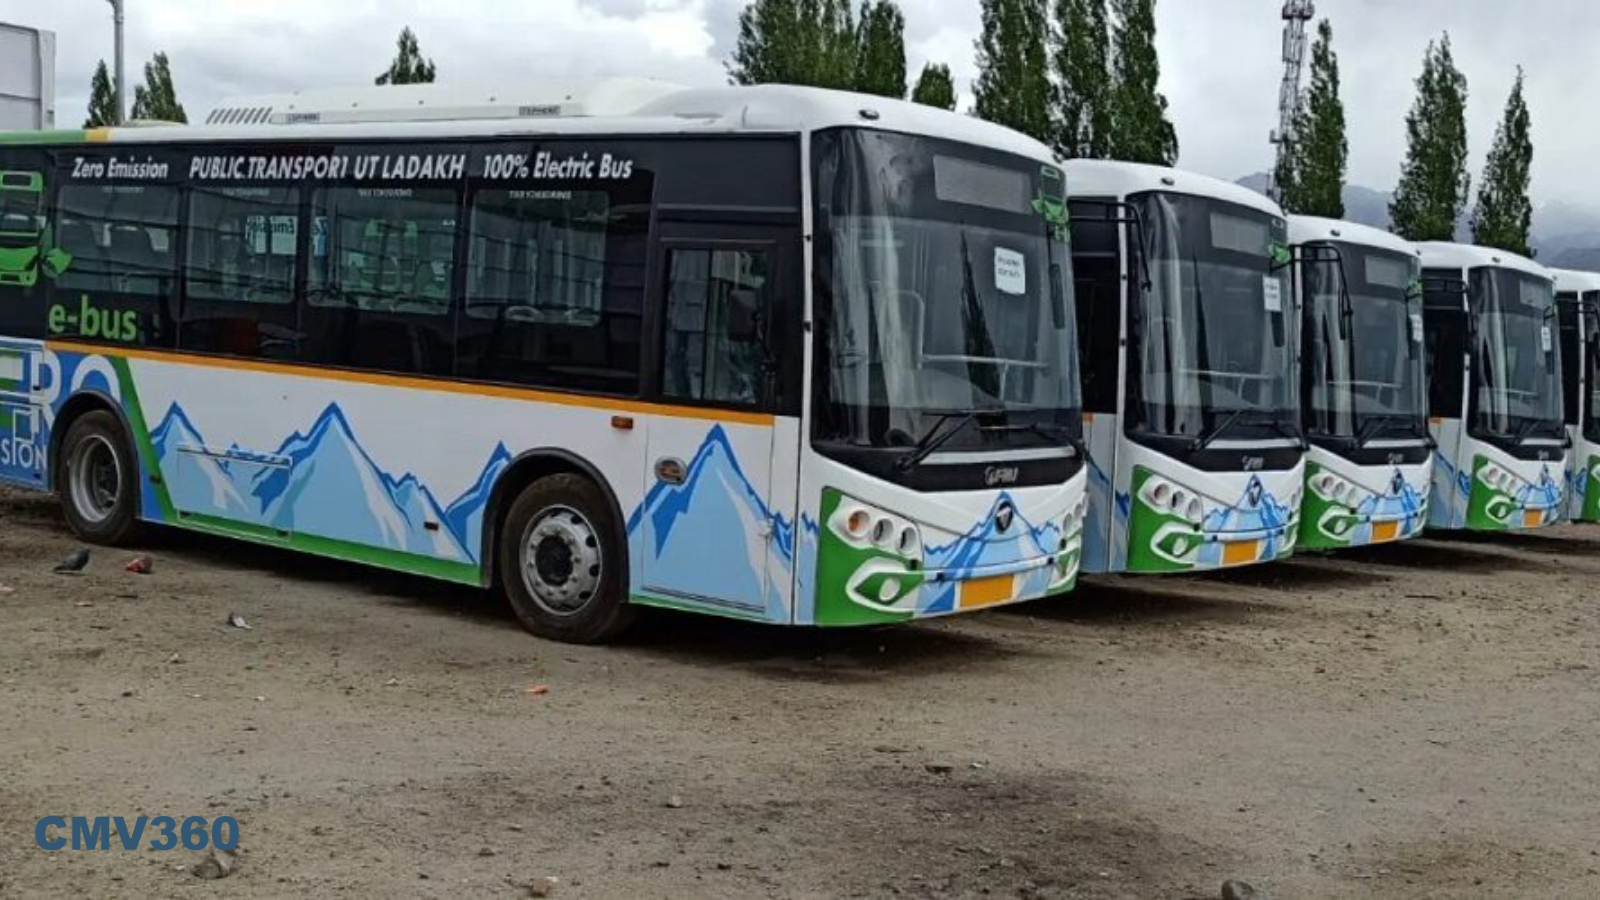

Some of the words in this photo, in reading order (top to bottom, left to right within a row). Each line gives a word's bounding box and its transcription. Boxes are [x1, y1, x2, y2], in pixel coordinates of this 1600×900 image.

[72, 158, 103, 177] Zero
[108, 157, 168, 178] Emission
[190, 157, 244, 178] PUBLIC
[354, 156, 380, 179] UT
[382, 155, 465, 178] LADAKH
[484, 154, 528, 178] 100%
[534, 152, 594, 178] Electric
[599, 154, 632, 178] Bus
[48, 294, 137, 341] e-bus
